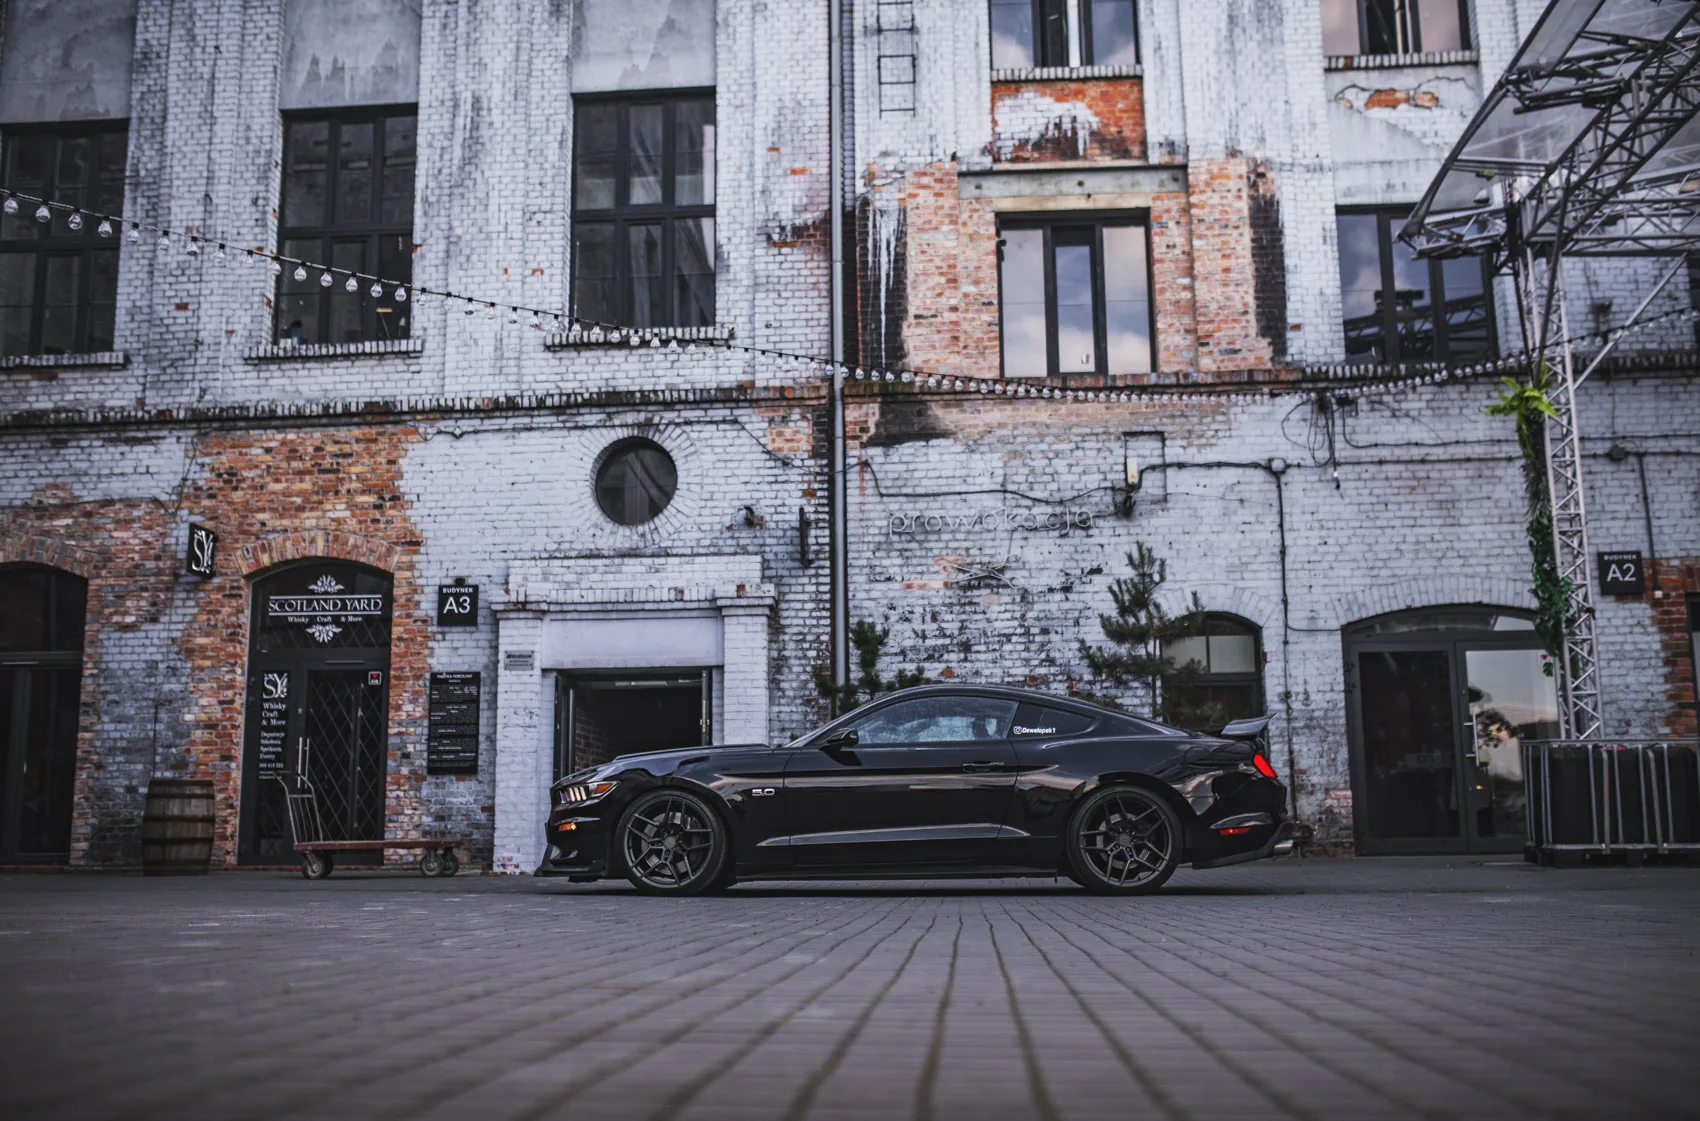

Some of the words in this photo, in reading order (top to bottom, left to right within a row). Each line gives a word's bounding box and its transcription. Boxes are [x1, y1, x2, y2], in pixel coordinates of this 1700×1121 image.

[890, 507, 1093, 537] prowokacja
[1606, 563, 1637, 582] A2
[268, 600, 341, 612] SCOTLAND
[345, 599, 382, 611] YARD
[443, 595, 470, 614] A3
[287, 616, 309, 624] Whisky
[263, 702, 286, 711] Whisky
[262, 710, 278, 718] Craft
[270, 718, 286, 726] More
[752, 788, 775, 796] 5.0
